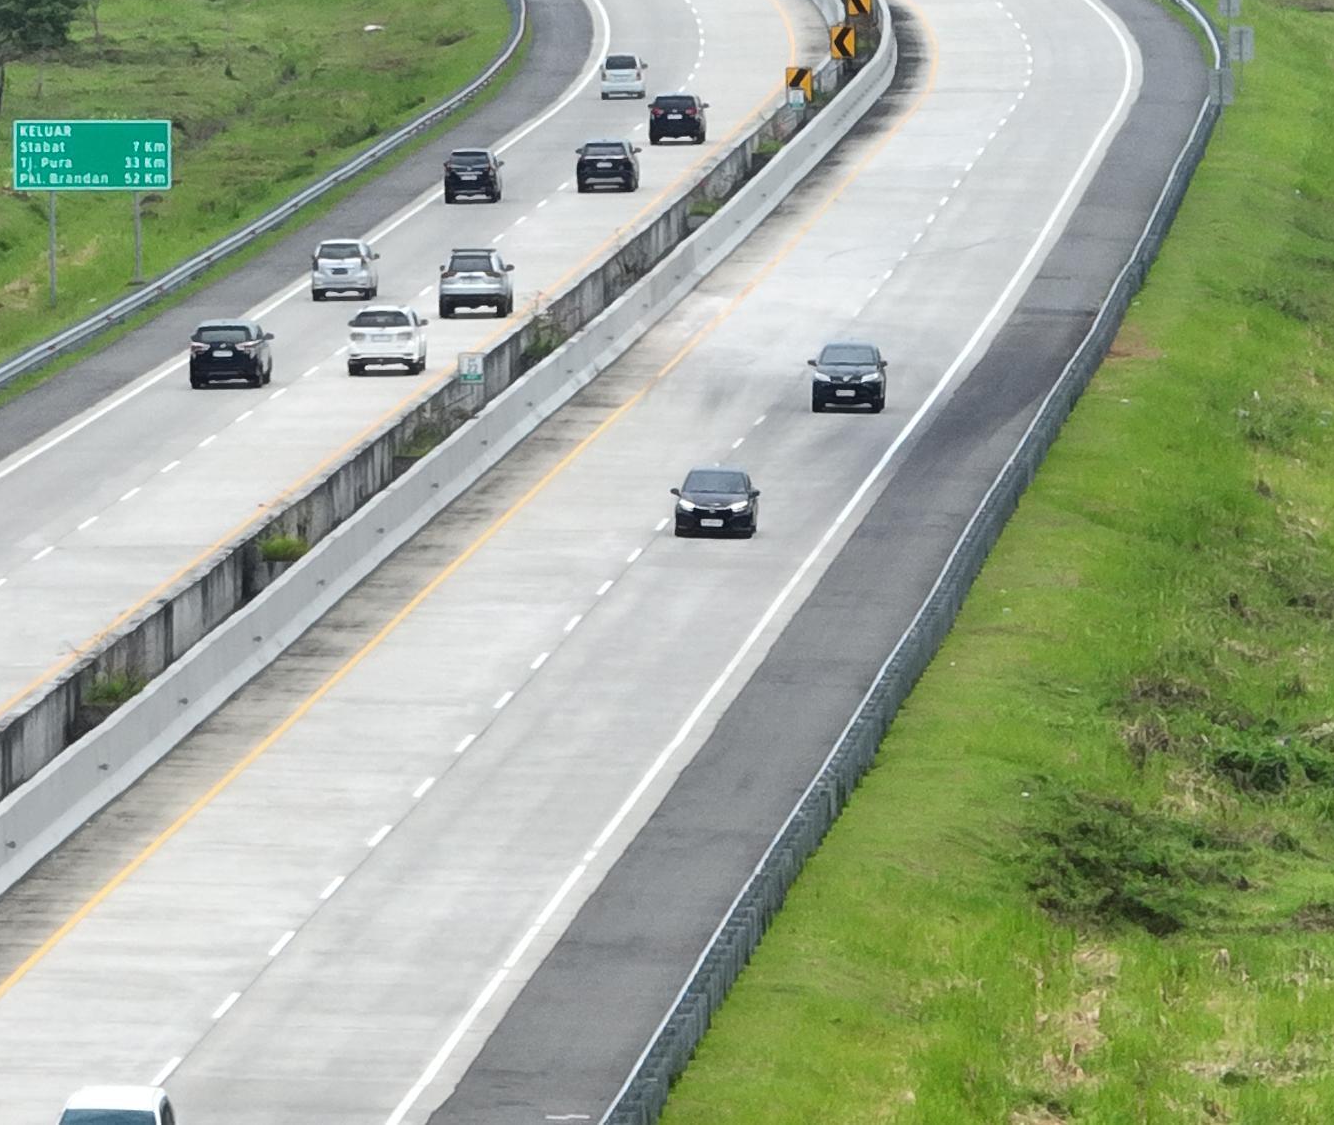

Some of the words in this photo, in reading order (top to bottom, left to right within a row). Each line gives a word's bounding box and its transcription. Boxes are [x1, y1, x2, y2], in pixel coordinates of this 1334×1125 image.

[20, 125, 72, 137] KELUAR
[20, 141, 65, 153] Stabat
[133, 141, 140, 152] 7
[144, 141, 165, 152] Km
[41, 157, 73, 168] Pura
[144, 157, 165, 168] Km
[49, 172, 108, 184] Brandan
[124, 172, 140, 184] 52
[144, 172, 165, 184] Km
